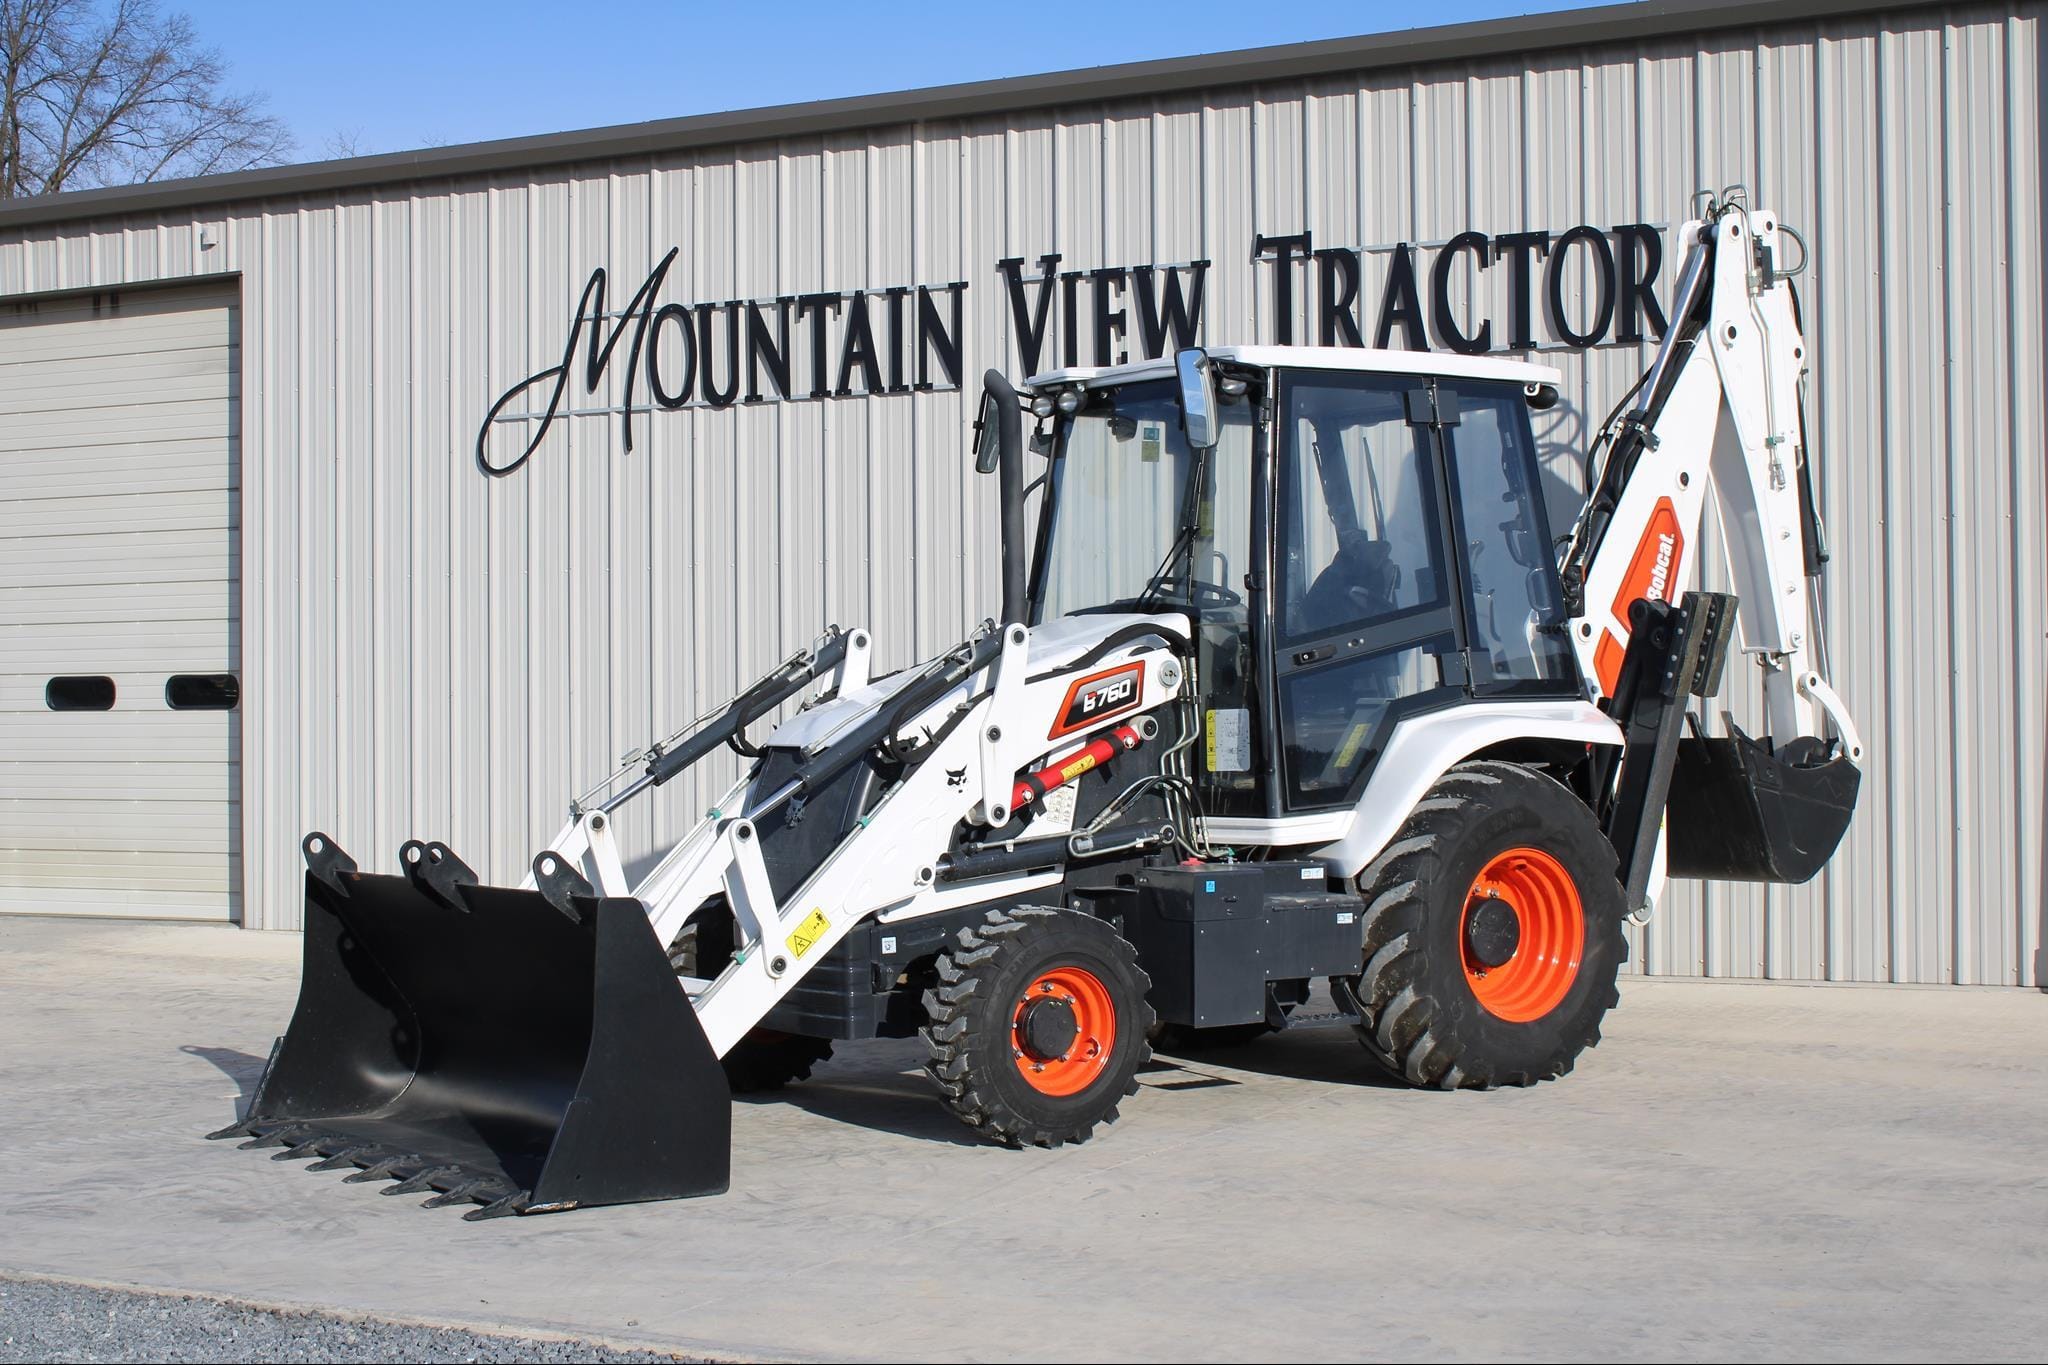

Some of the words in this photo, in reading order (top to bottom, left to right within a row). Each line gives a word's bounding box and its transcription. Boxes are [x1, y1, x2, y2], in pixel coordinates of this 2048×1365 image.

[477, 246, 969, 475] MOUNTAIN
[998, 253, 1212, 378] VIEW
[1255, 224, 1669, 354] TRACTOR
[1084, 678, 1131, 713] B760
